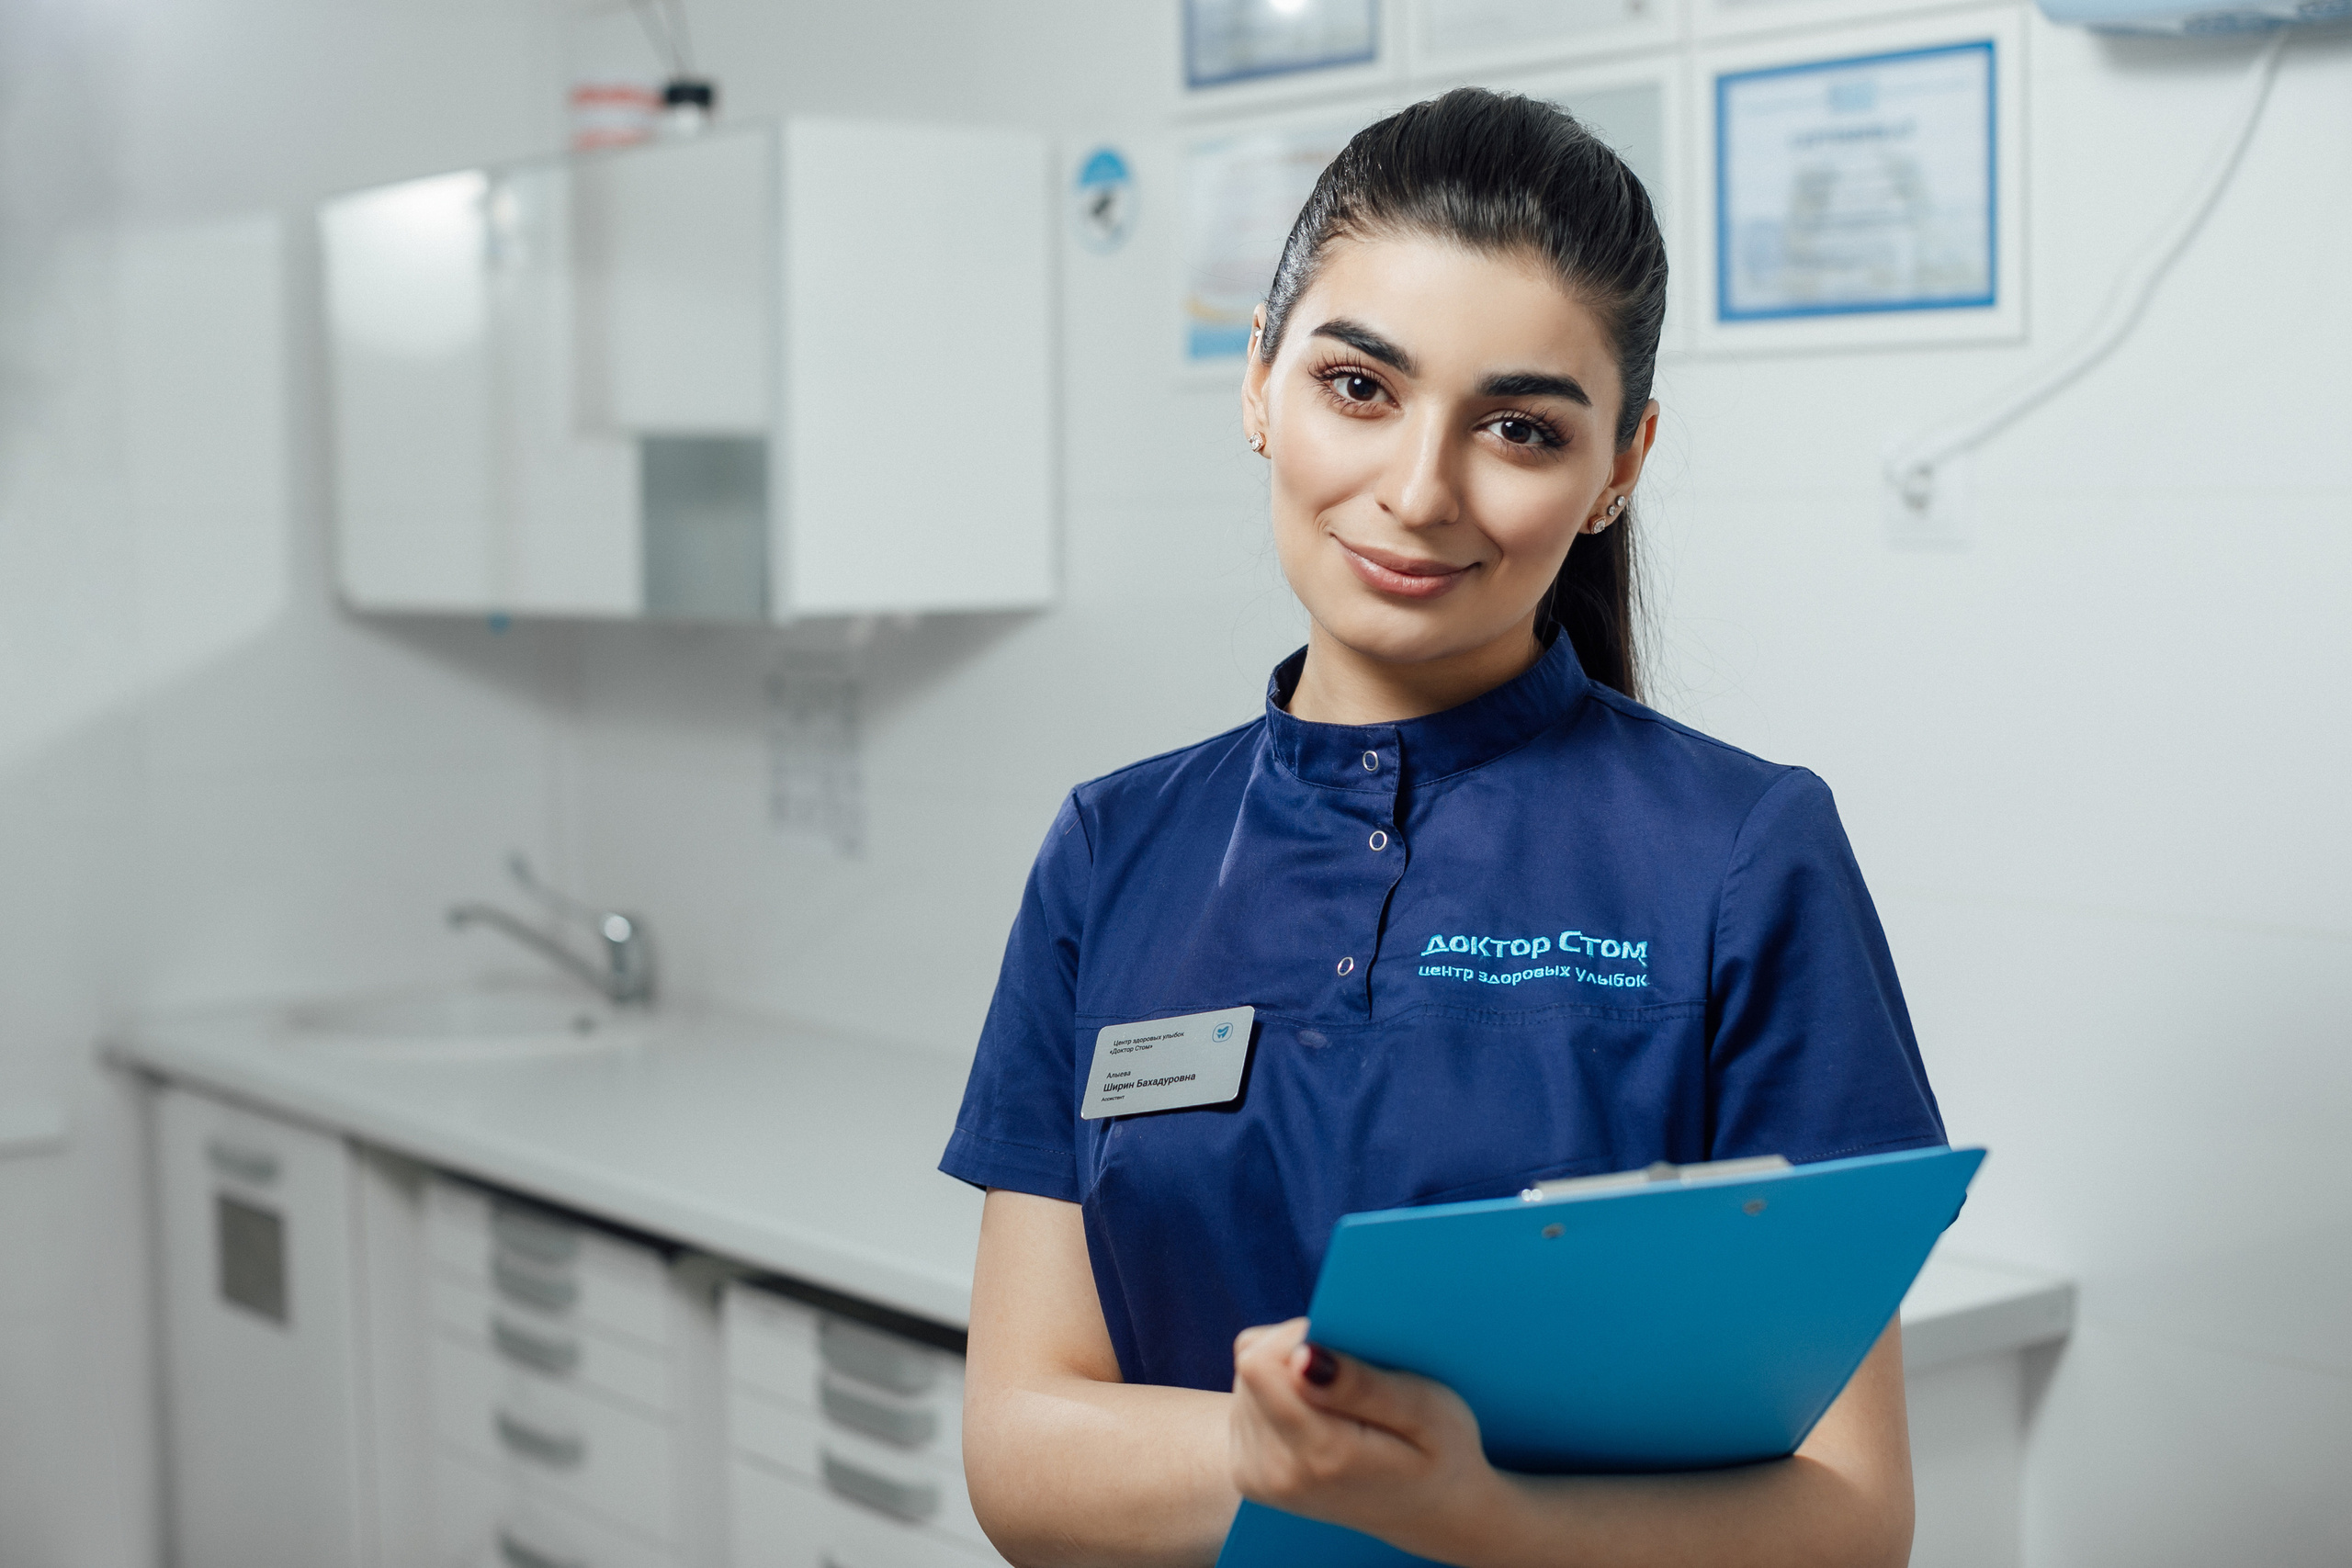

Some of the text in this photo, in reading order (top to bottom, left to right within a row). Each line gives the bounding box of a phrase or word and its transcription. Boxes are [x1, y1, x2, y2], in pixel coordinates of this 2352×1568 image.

[1478, 964, 1571, 987] здоровых
[1133, 1034, 1162, 1044] здоровых
[1162, 1031, 1185, 1041] улыбок
[1109, 1047, 1134, 1055] «Доктор
[1102, 1073, 1196, 1092] Ширин Бахадуровна
